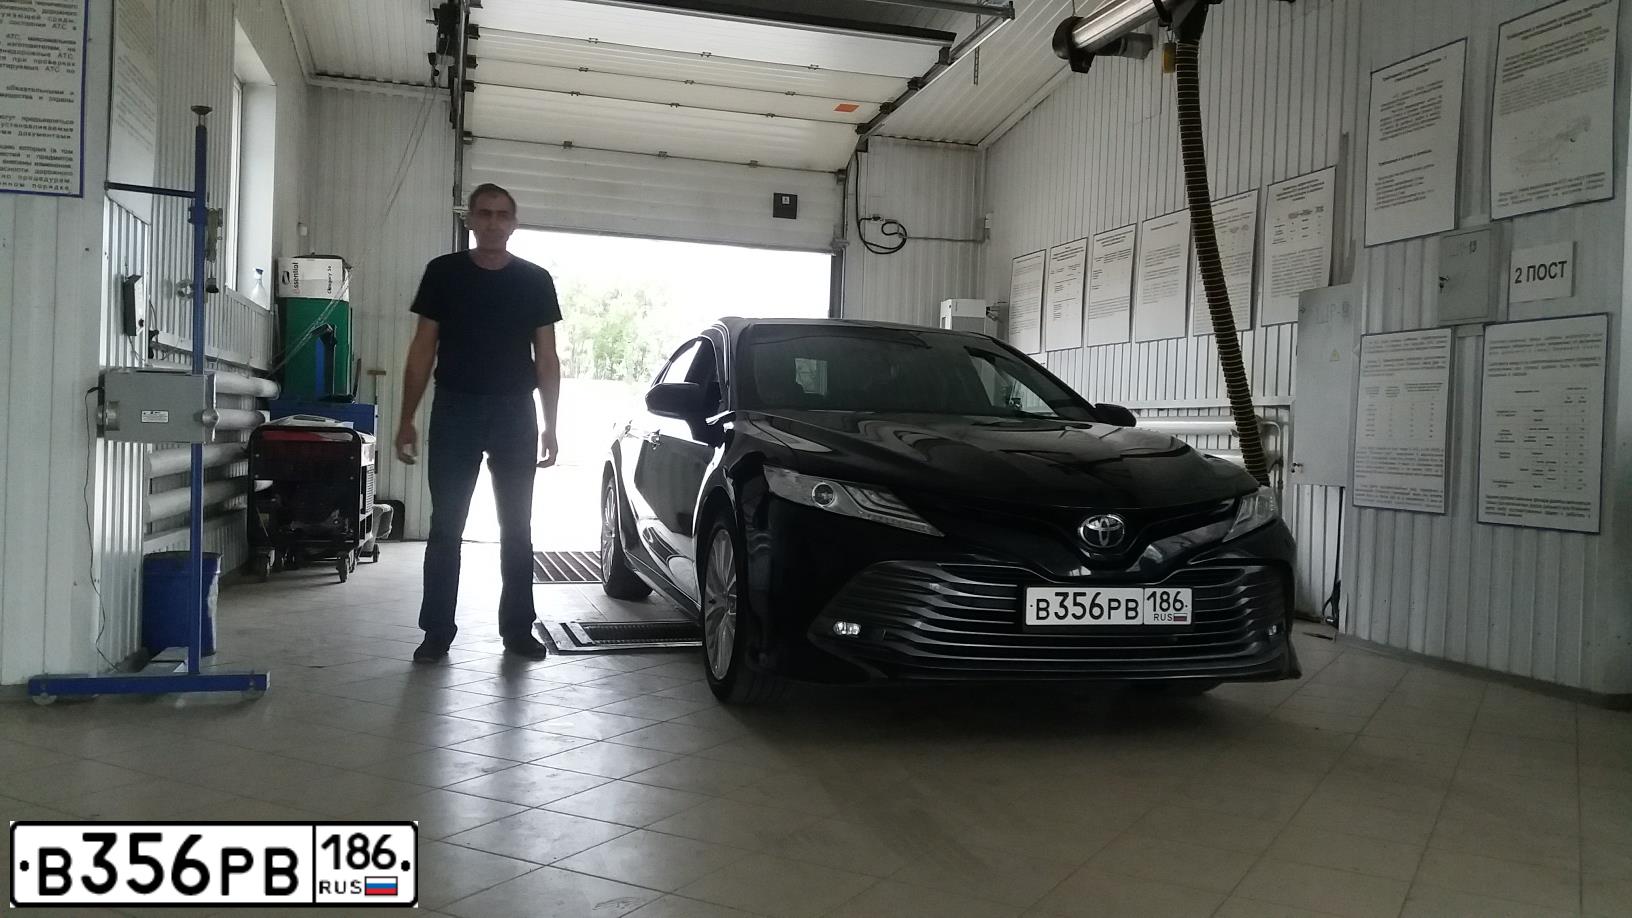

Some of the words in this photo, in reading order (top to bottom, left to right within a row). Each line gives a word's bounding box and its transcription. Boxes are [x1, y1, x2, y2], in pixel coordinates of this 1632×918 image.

[1514, 267, 1522, 284] 2
[1526, 260, 1568, 282] ПОСТ
[1146, 590, 1185, 612] 186
[1153, 613, 1173, 622] RUS
